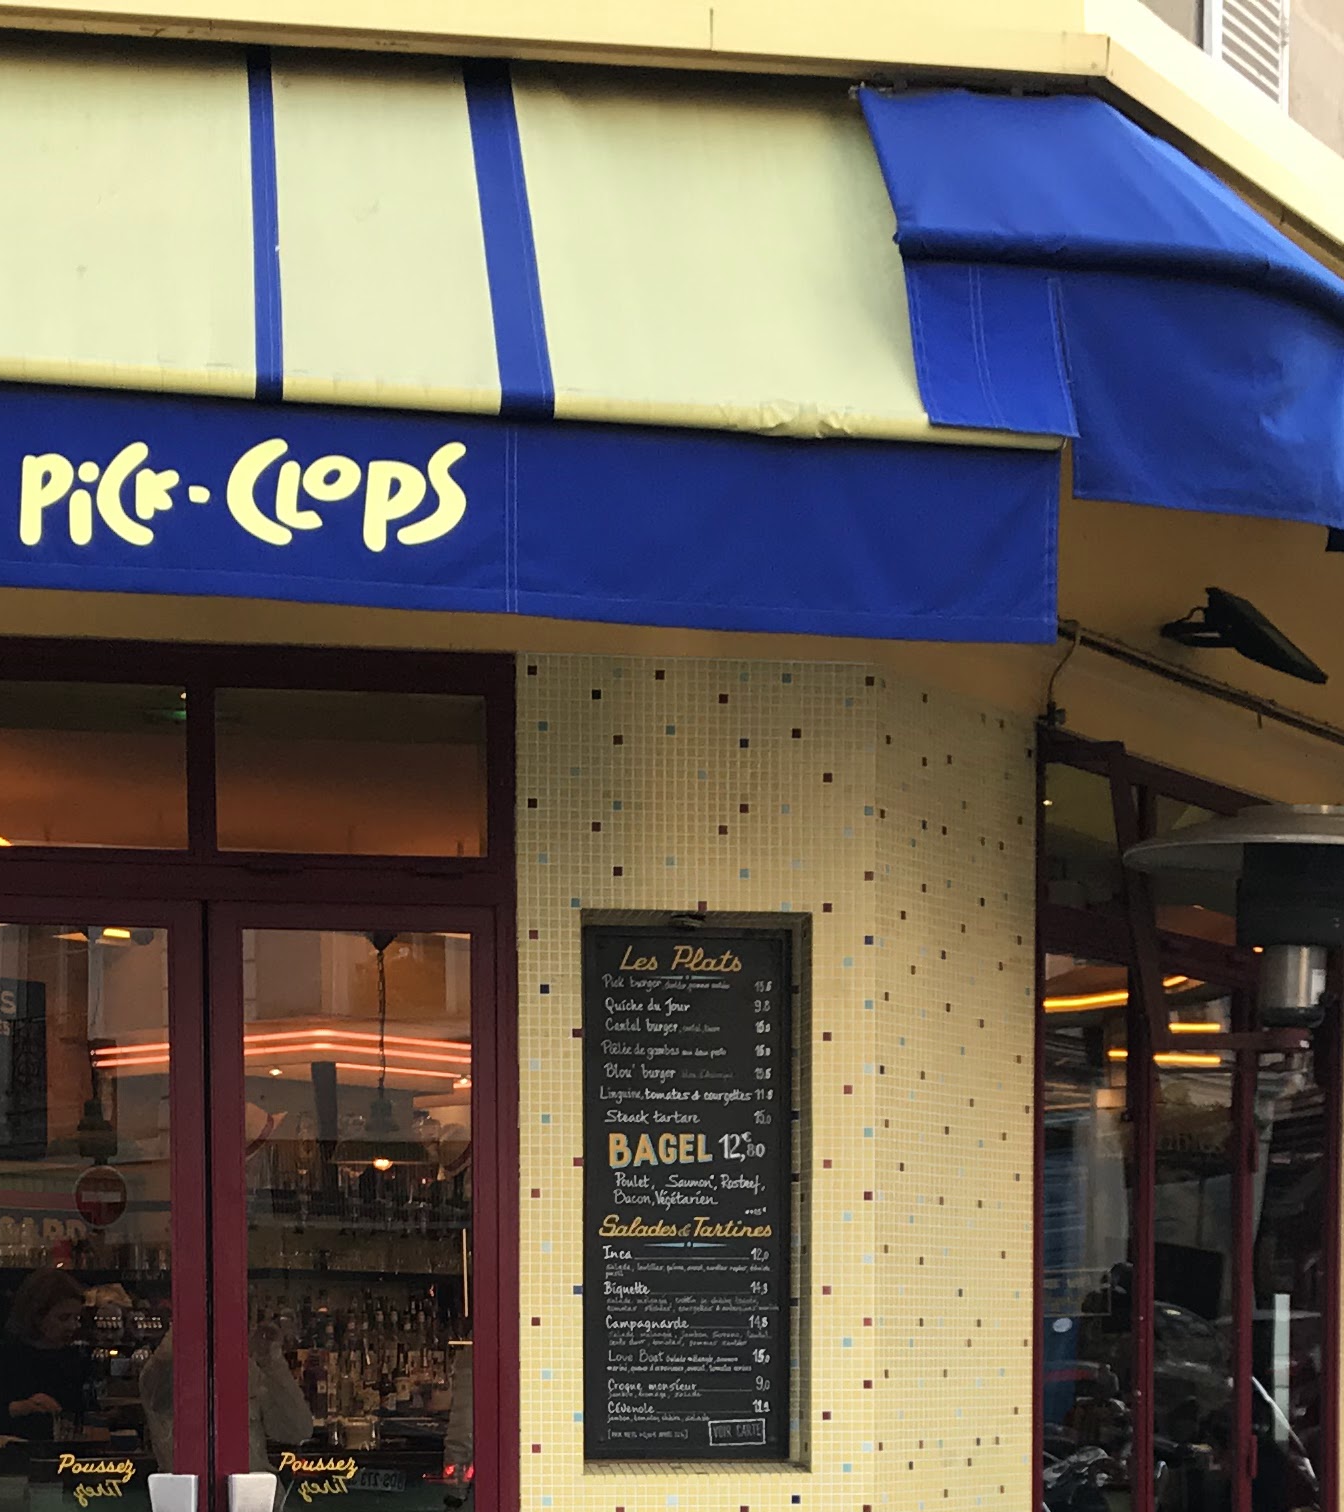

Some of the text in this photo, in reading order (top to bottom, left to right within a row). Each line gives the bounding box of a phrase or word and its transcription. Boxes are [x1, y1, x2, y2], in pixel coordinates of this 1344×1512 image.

[619, 945, 742, 972] Les Plats
[630, 976, 661, 993] burger
[605, 997, 644, 1014] Quiche
[647, 997, 661, 1011] du
[645, 1018, 678, 1036] burger
[633, 1043, 645, 1056] de
[640, 1063, 676, 1084] burger
[645, 1089, 691, 1101] tomates
[703, 1089, 752, 1106] courgettes
[604, 1110, 650, 1125] Steack
[653, 1110, 700, 1124] tartare
[609, 1132, 713, 1169] BAGEL
[613, 1189, 655, 1206] Bacon,
[599, 1214, 772, 1238] Salades & Tartines
[602, 1245, 633, 1260] Inca
[604, 1281, 651, 1300] Biquette
[606, 1314, 689, 1333] Campagnarde
[608, 1349, 634, 1363] Love
[639, 1348, 664, 1363] Boat
[608, 1378, 642, 1393] Croque
[648, 1378, 697, 1392] monsieur
[713, 1424, 762, 1438] VOIR CARTE
[57, 1454, 136, 1483] Poussez
[279, 1452, 358, 1480] Poussez
